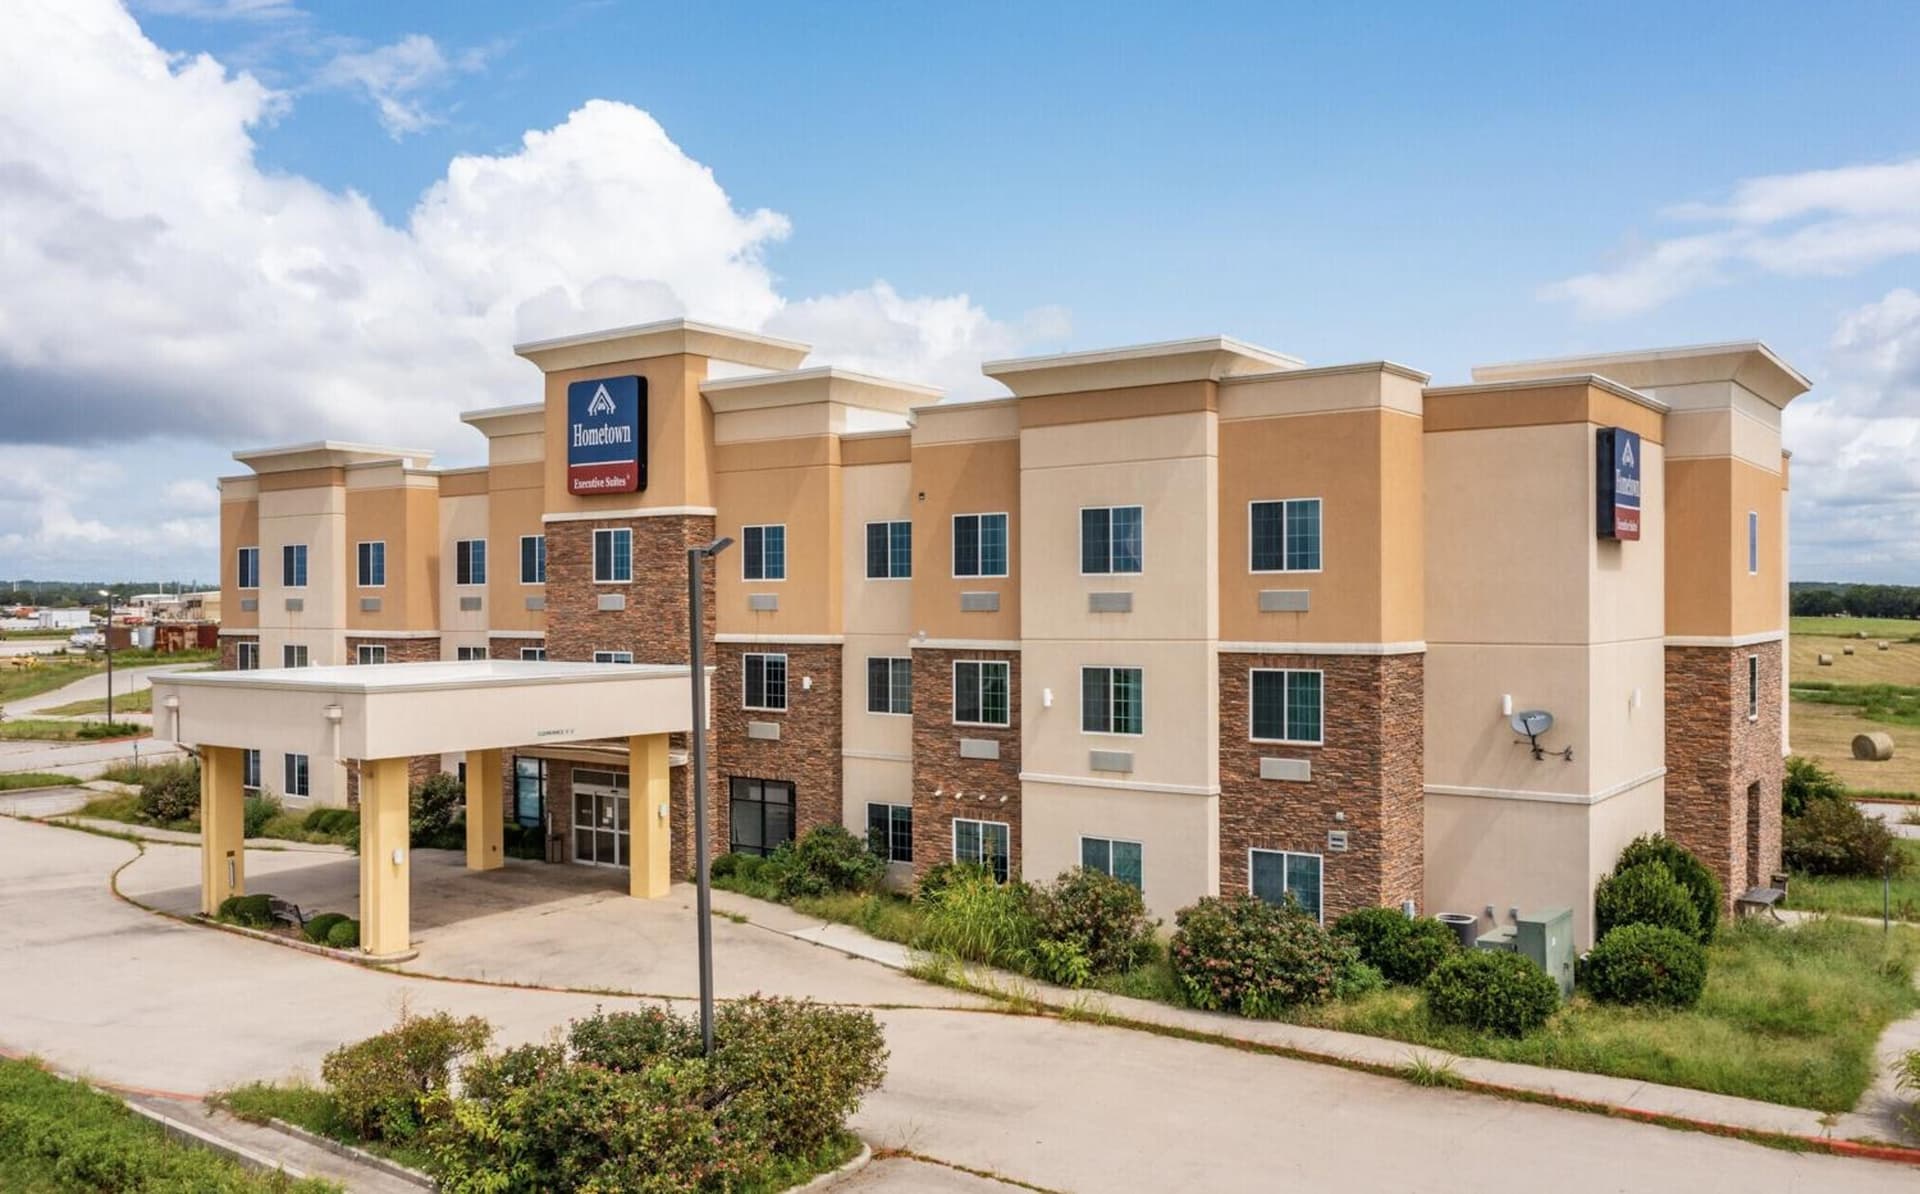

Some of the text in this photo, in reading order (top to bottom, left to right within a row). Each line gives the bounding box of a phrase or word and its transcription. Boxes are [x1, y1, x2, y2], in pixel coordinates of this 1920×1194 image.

[573, 423, 632, 447] Hometown
[574, 475, 626, 489] Executive Suites
